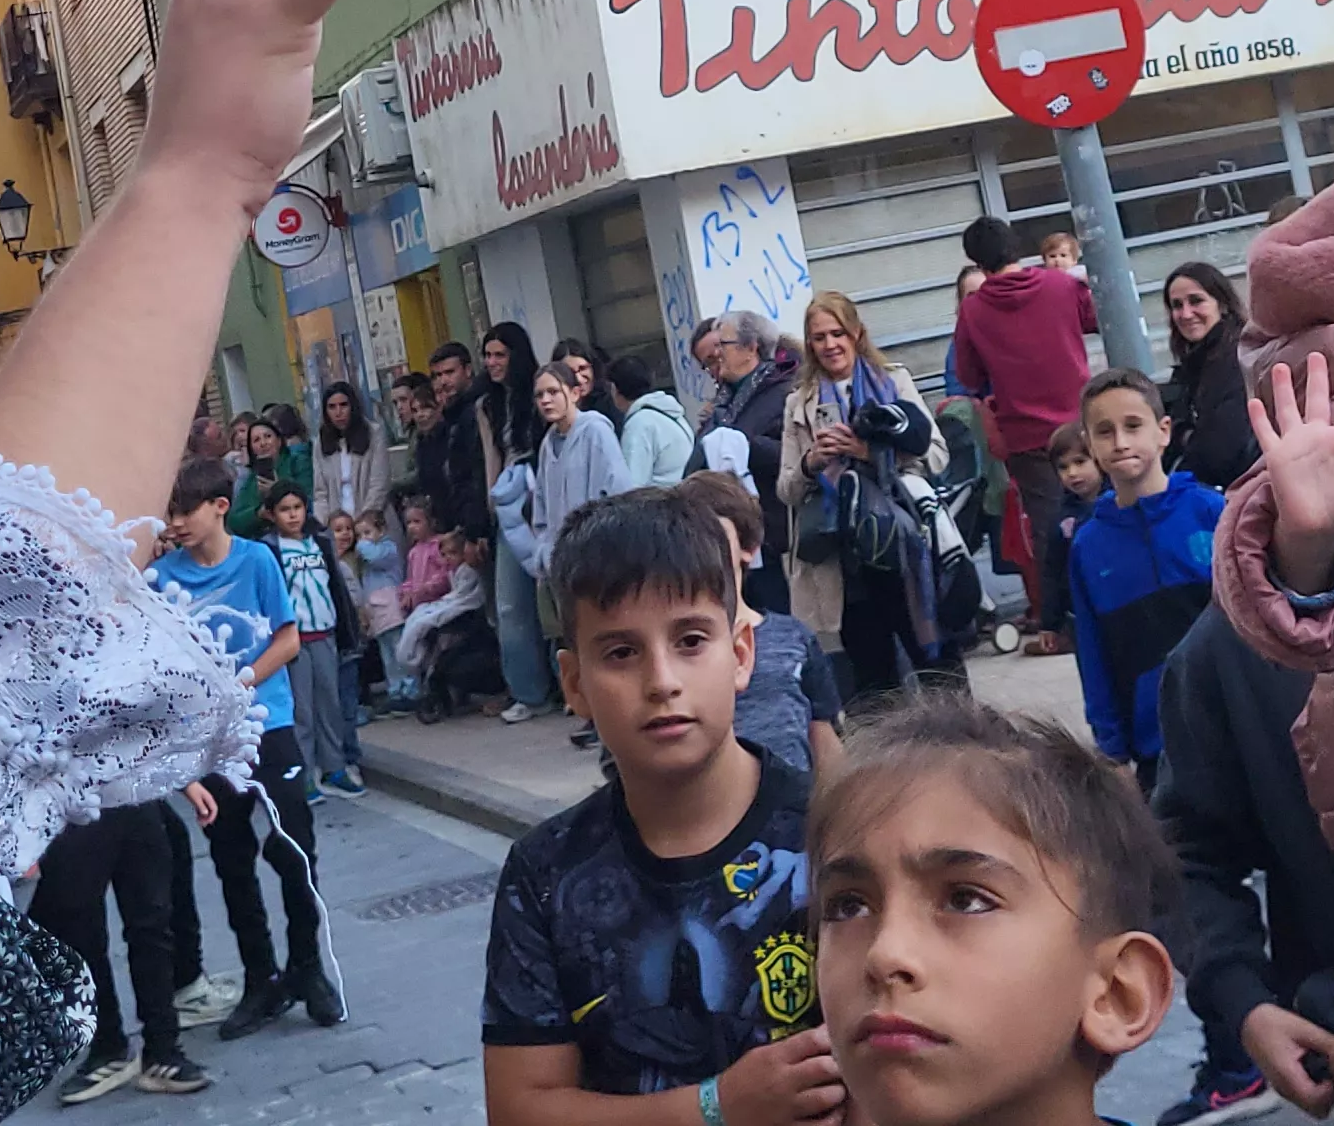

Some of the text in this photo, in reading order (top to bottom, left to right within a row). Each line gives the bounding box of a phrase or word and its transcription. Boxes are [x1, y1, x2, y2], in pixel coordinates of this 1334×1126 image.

[1167, 44, 1191, 74] el
[1196, 41, 1239, 70] año
[1246, 37, 1301, 61] 1858.
[265, 233, 320, 250] MoneyGram
[291, 555, 325, 570] NASA
